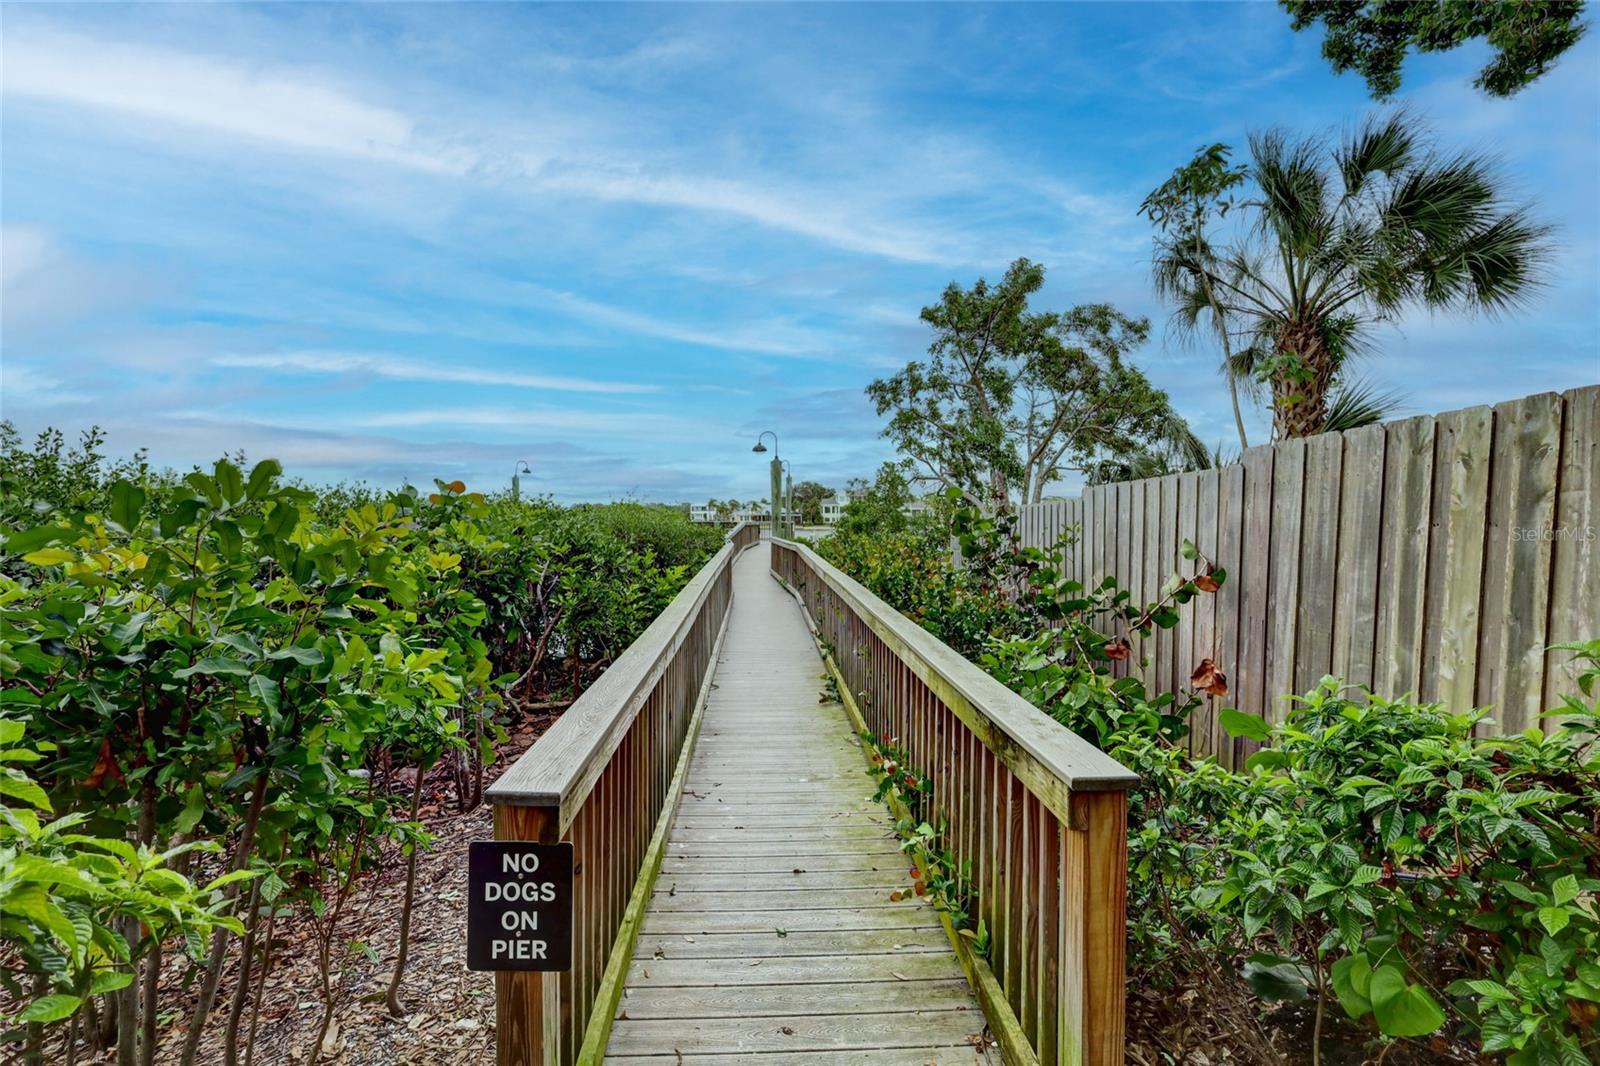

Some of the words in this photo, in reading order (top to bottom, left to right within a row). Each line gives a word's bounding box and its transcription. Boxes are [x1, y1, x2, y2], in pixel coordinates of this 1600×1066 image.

[502, 853, 539, 873] NO
[484, 882, 556, 902] DOGS
[501, 911, 538, 931] ON
[491, 939, 547, 960] PIER
